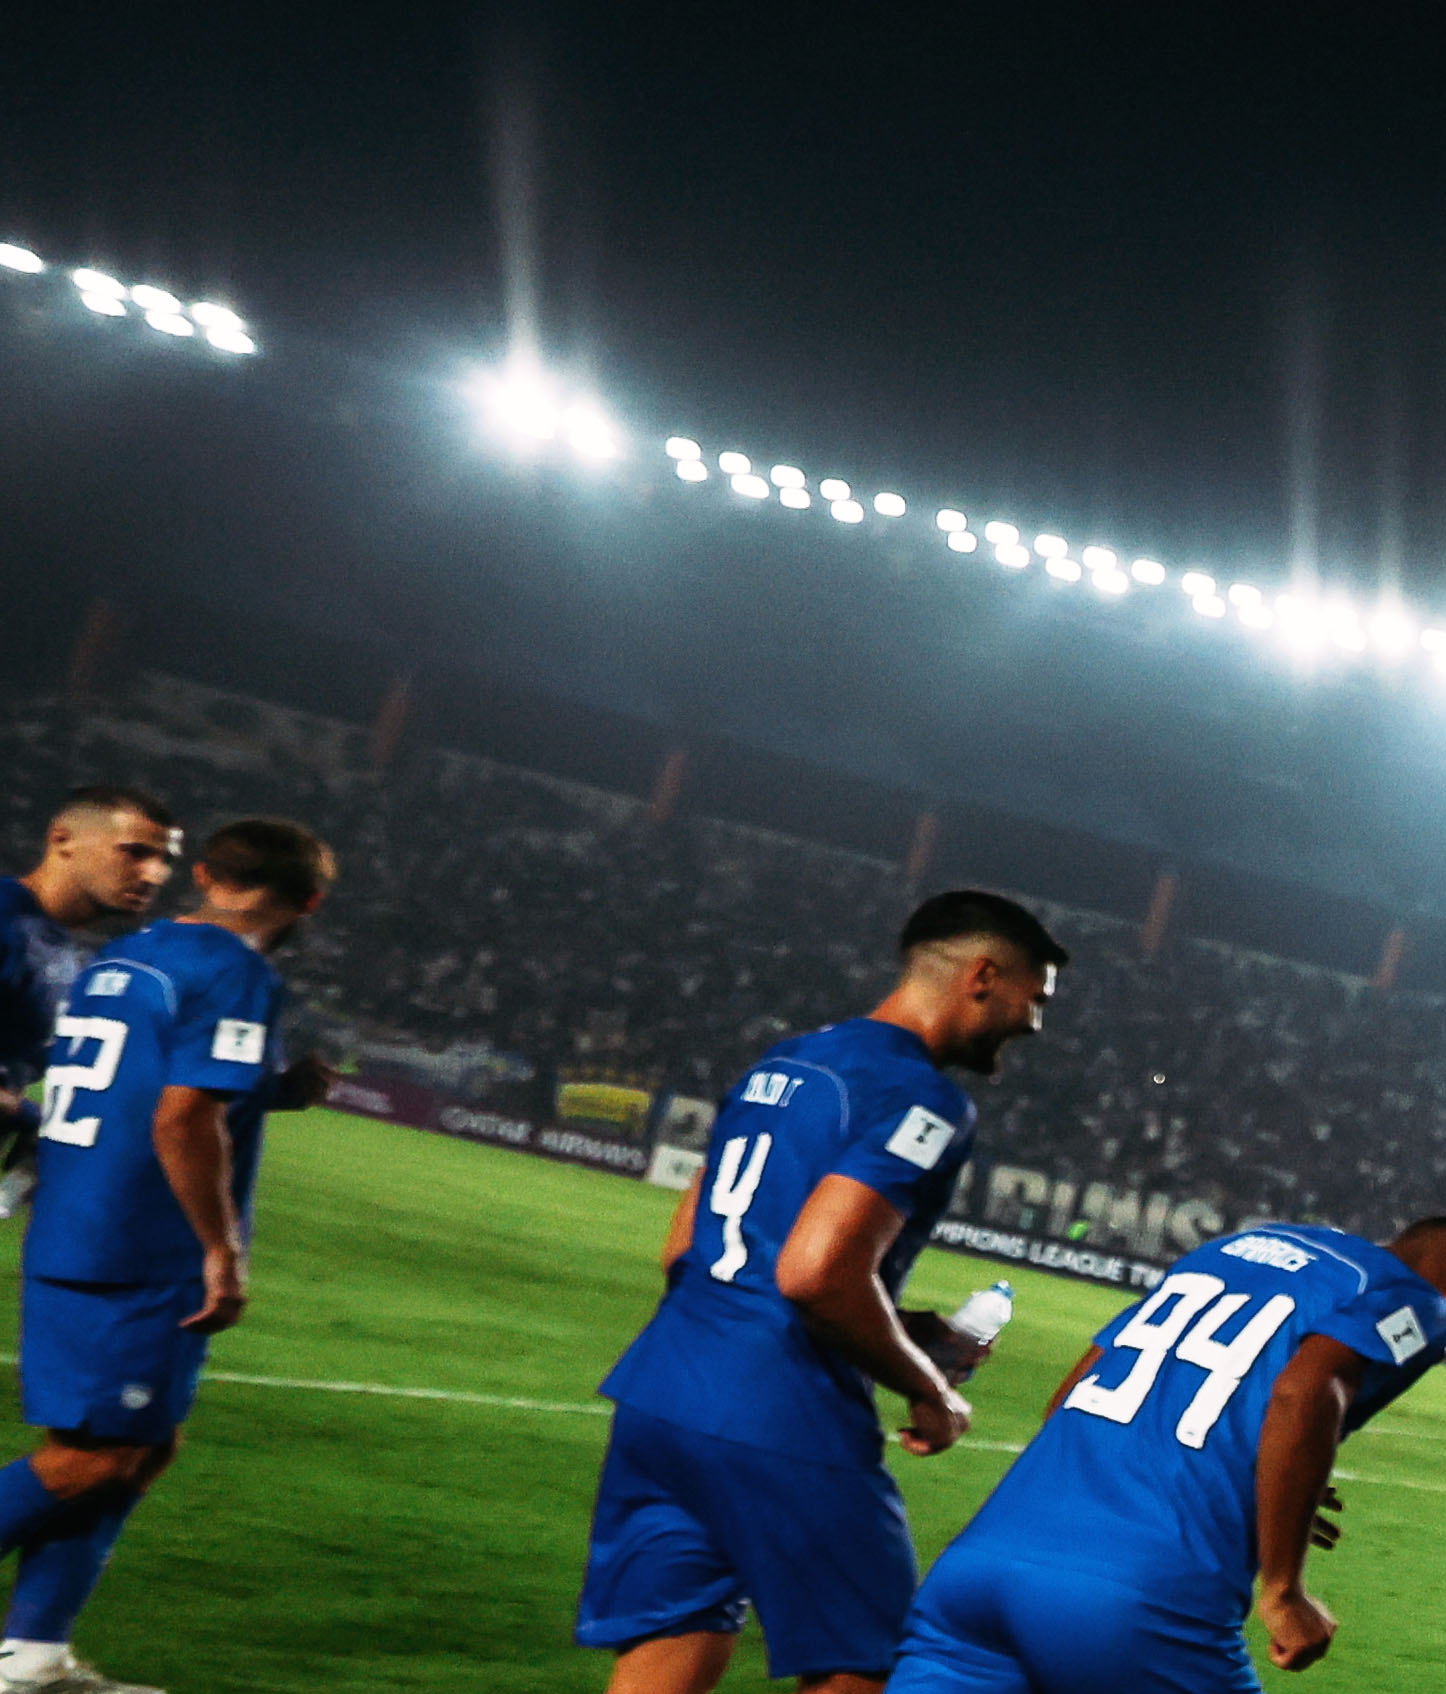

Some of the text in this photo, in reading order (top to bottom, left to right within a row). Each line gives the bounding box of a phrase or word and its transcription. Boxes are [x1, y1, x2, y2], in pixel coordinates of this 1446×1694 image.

[709, 1132, 773, 1283] 4
[1029, 1241, 1126, 1283] LEAGUE
[1063, 1272, 1295, 1449] 94
